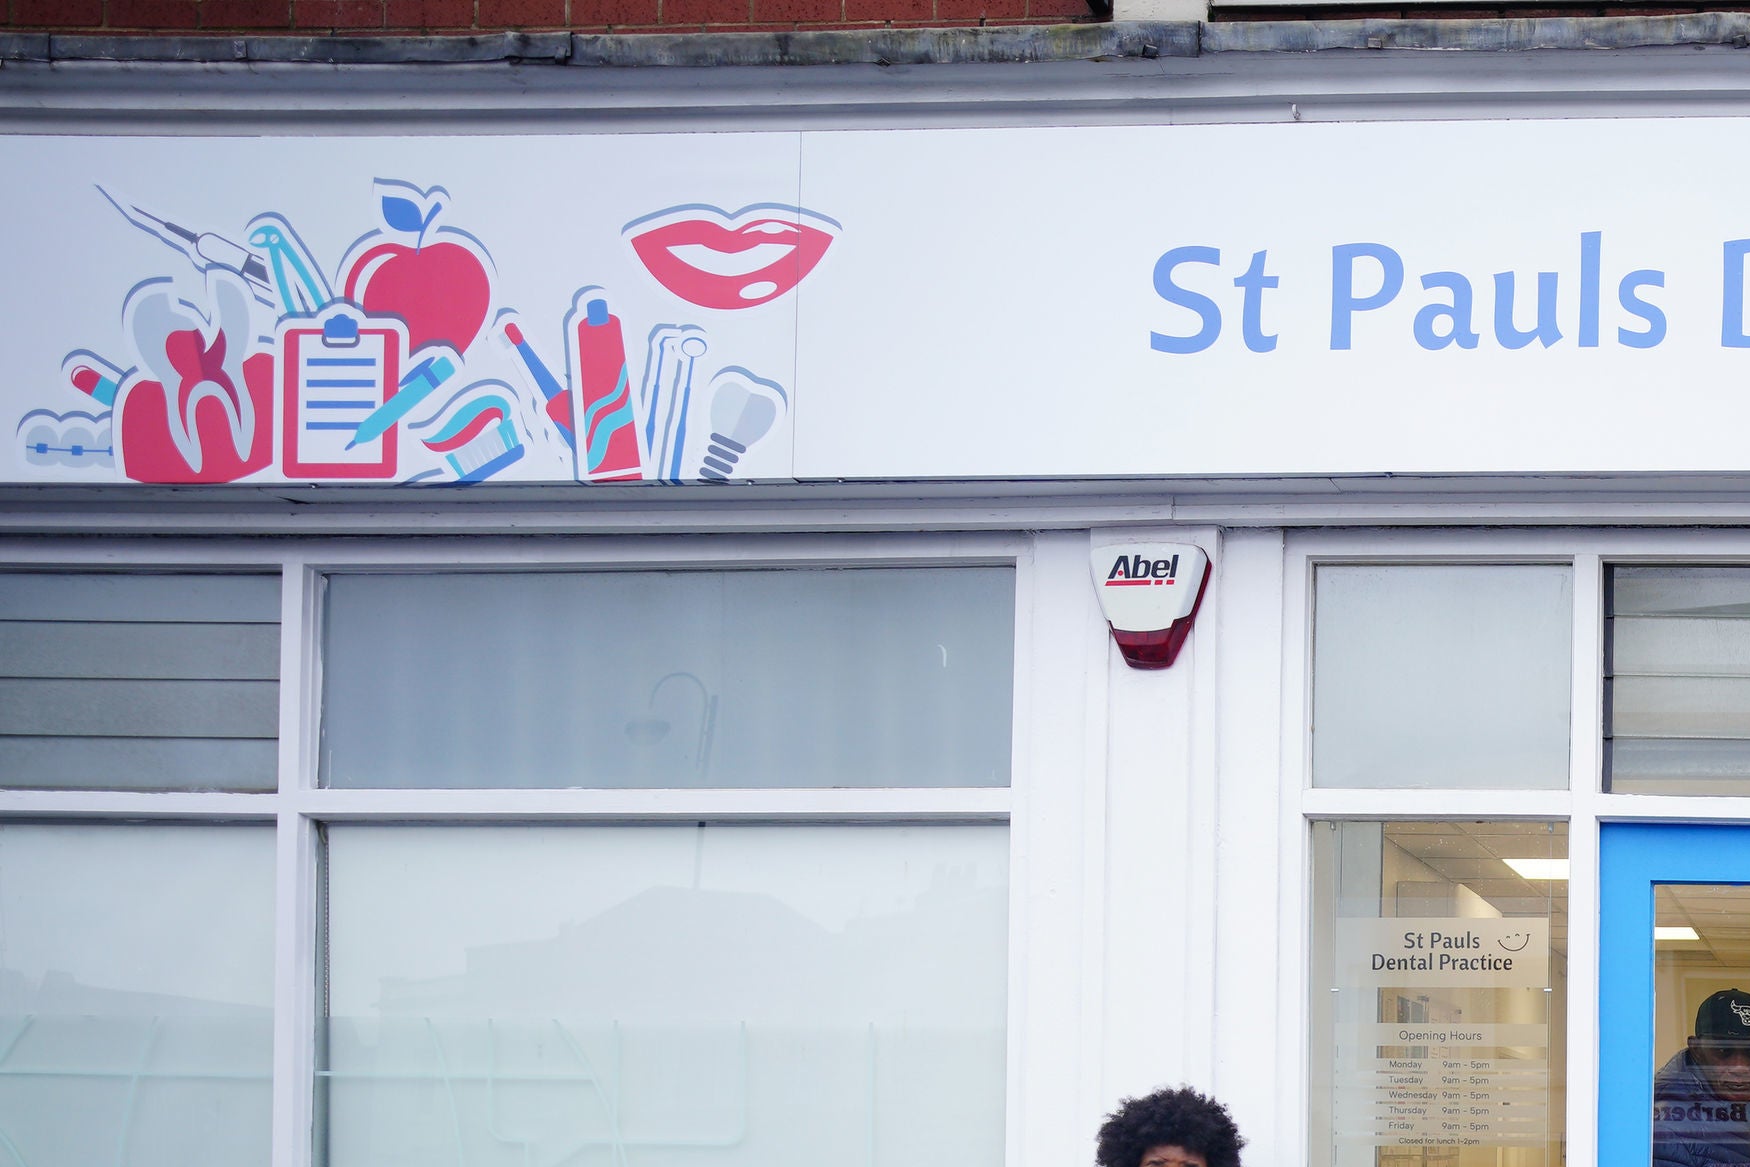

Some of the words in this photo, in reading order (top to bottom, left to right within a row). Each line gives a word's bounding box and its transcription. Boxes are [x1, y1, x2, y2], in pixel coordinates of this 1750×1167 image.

[1150, 245, 1280, 354] St
[1330, 231, 1667, 351] Pauls
[1108, 554, 1180, 579] Abel
[1404, 932, 1424, 949] St
[1430, 931, 1480, 949] Pauls
[1372, 953, 1433, 971] Dental
[1439, 953, 1513, 971] Practice
[1399, 1030, 1446, 1043] Opening
[1450, 1030, 1482, 1041] Hours
[1389, 1060, 1422, 1069] Monday
[1471, 1061, 1489, 1069] 5pm
[1389, 1076, 1423, 1084] Tuesday
[1469, 1076, 1489, 1085] 5pm
[1389, 1091, 1437, 1099] Wednesday
[1442, 1091, 1460, 1099] 9am
[1470, 1091, 1489, 1100] 5pm
[1389, 1106, 1427, 1115] Thursday
[1470, 1107, 1489, 1115] 5pm
[1388, 1122, 1415, 1130] Friday
[1470, 1122, 1489, 1131] 5pm
